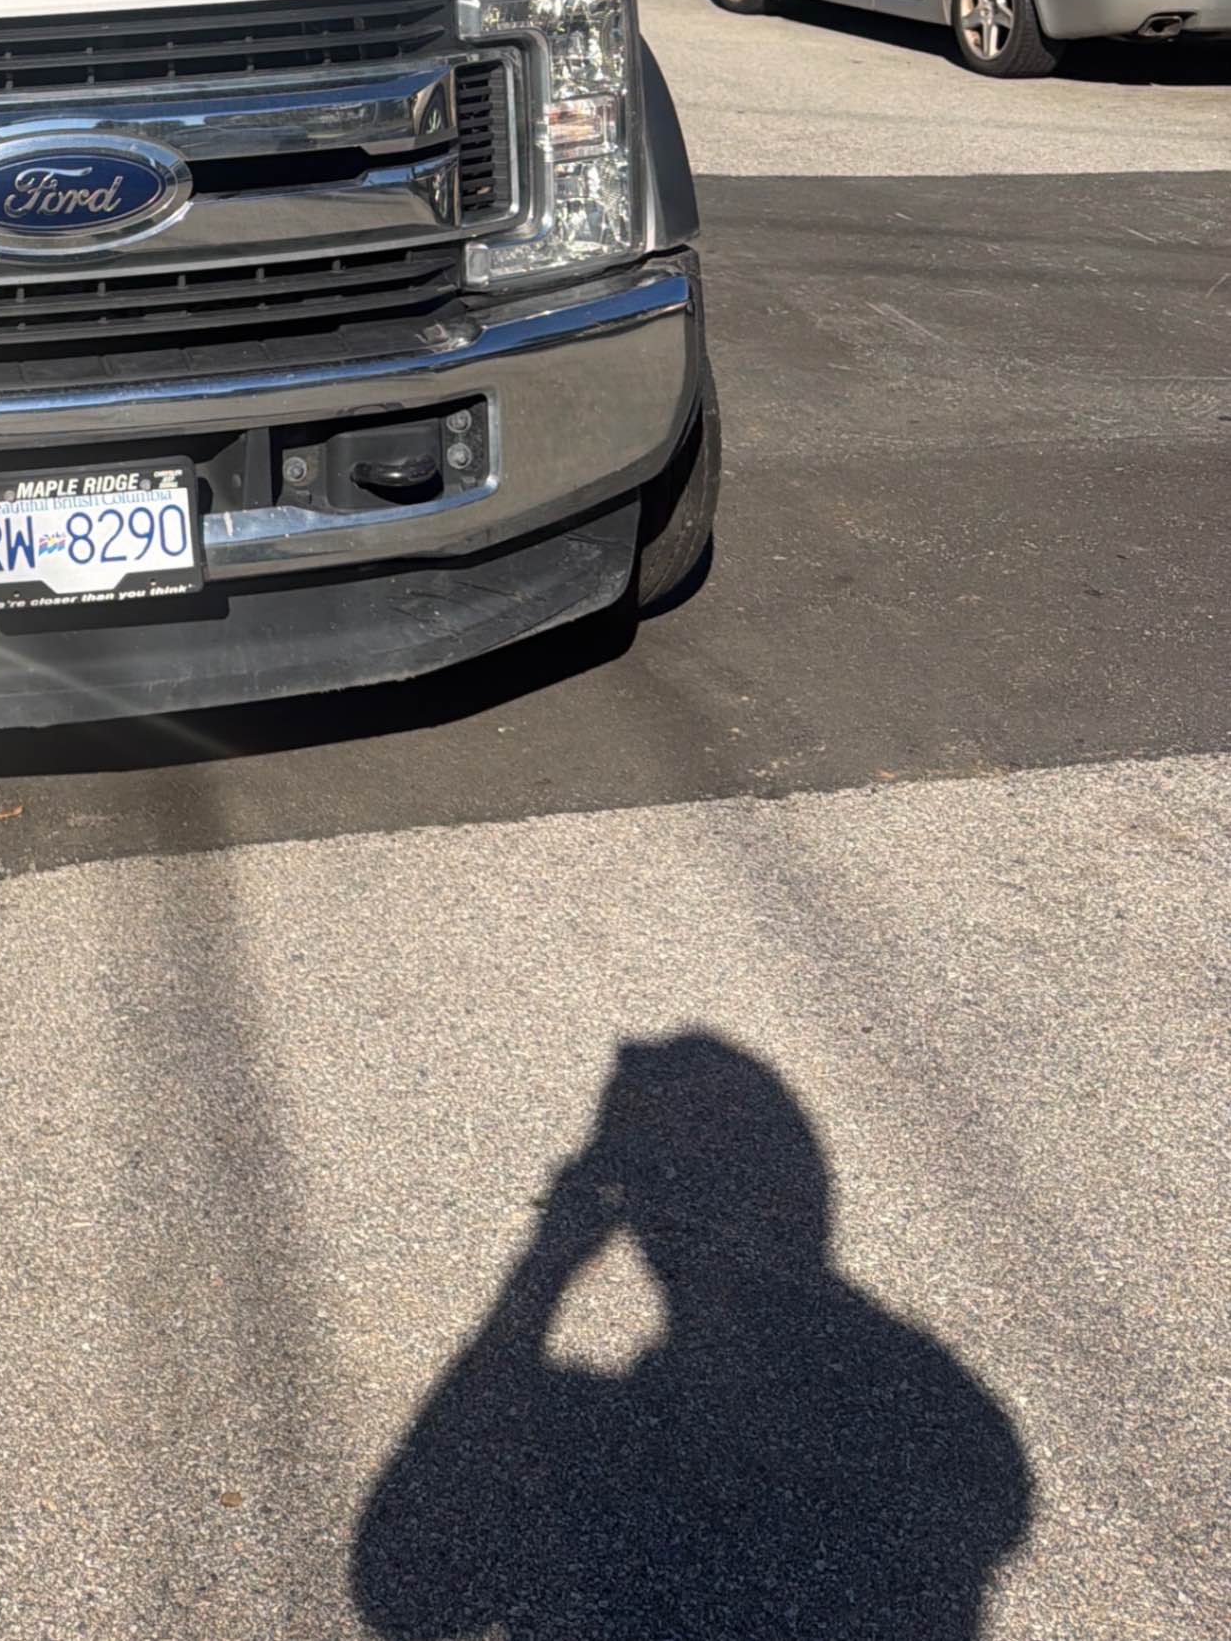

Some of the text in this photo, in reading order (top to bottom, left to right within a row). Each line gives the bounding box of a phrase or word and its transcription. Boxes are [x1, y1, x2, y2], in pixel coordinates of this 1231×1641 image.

[4, 167, 123, 218] Ford
[16, 478, 78, 499] MAPLE
[82, 473, 140, 494] RIDGE
[52, 493, 100, 509] British
[101, 489, 172, 507] Columbia
[66, 504, 188, 564] 8290
[30, 596, 78, 607] closer
[81, 591, 115, 603] than
[118, 589, 146, 601] you
